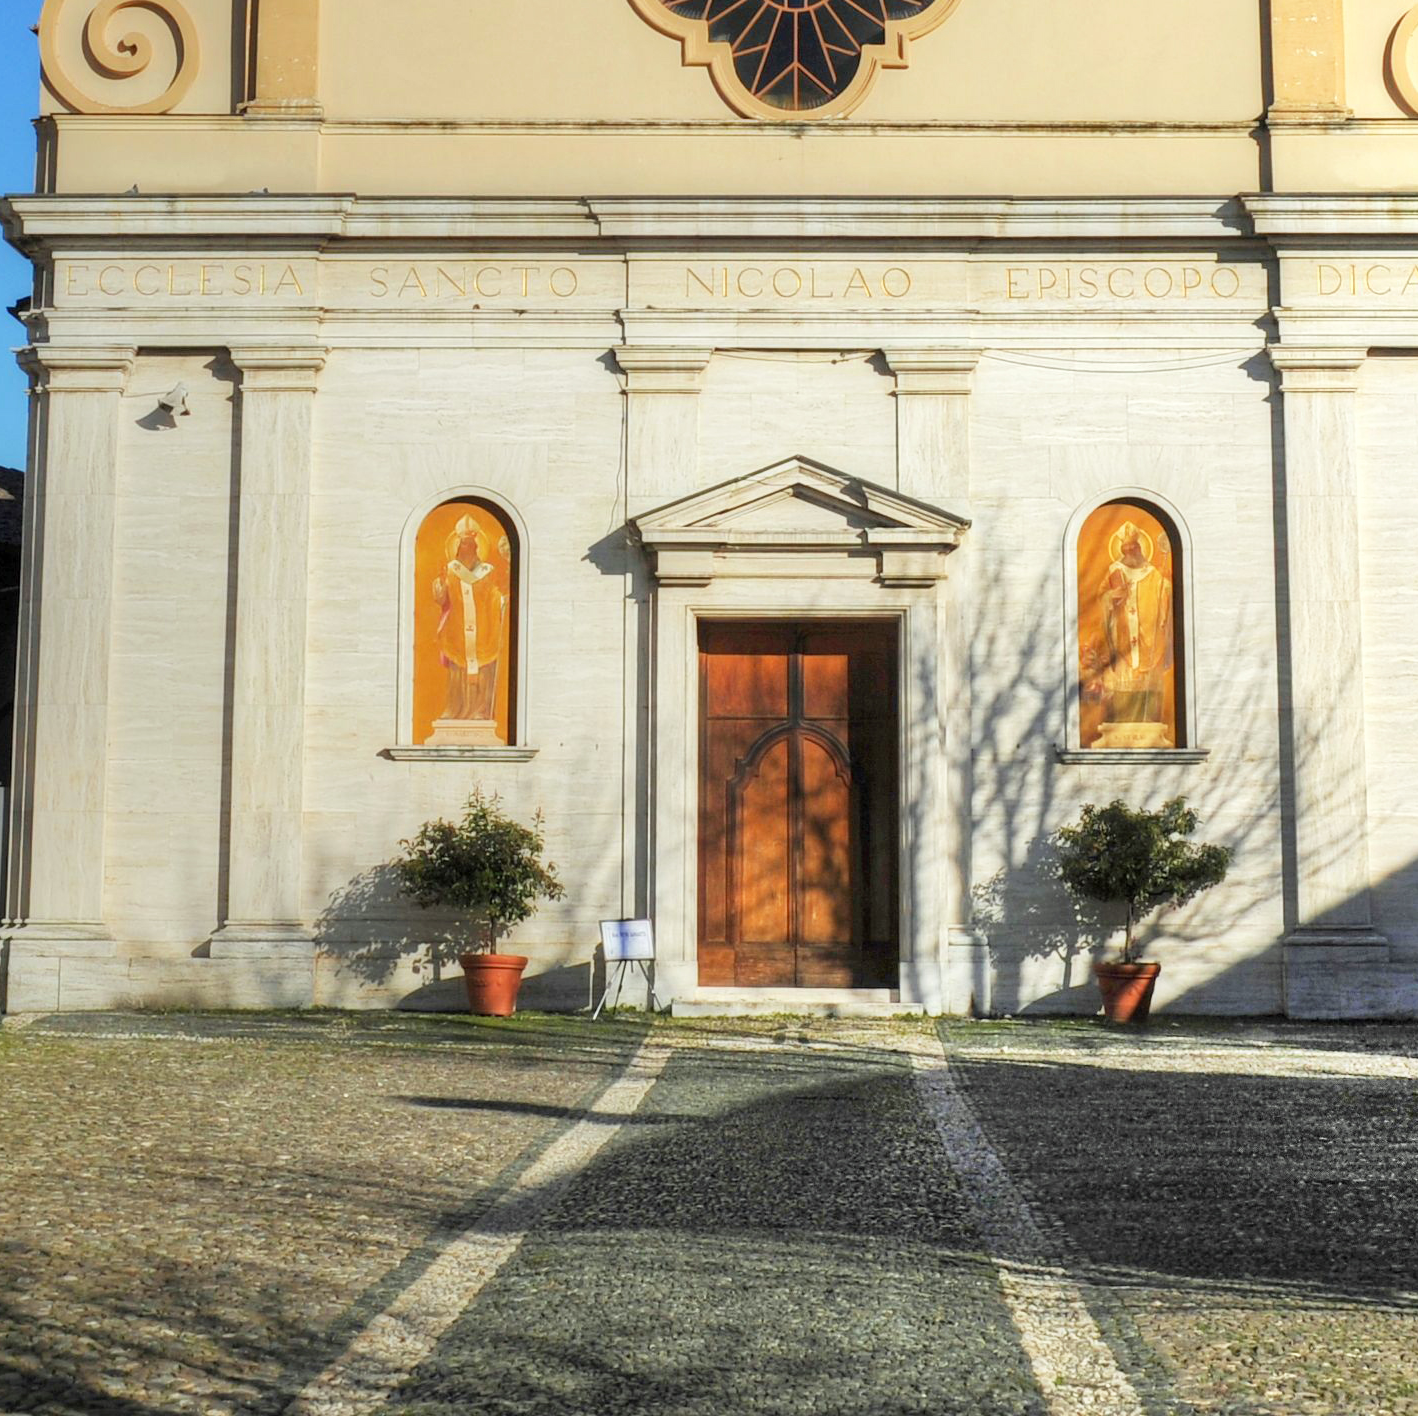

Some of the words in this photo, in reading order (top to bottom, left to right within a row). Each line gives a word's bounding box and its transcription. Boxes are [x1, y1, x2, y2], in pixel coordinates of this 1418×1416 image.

[66, 264, 303, 296] ECCLESIA
[369, 266, 578, 298] SANCTO
[686, 267, 912, 298] NICOLAO
[1005, 267, 1240, 299] EPISCOPO
